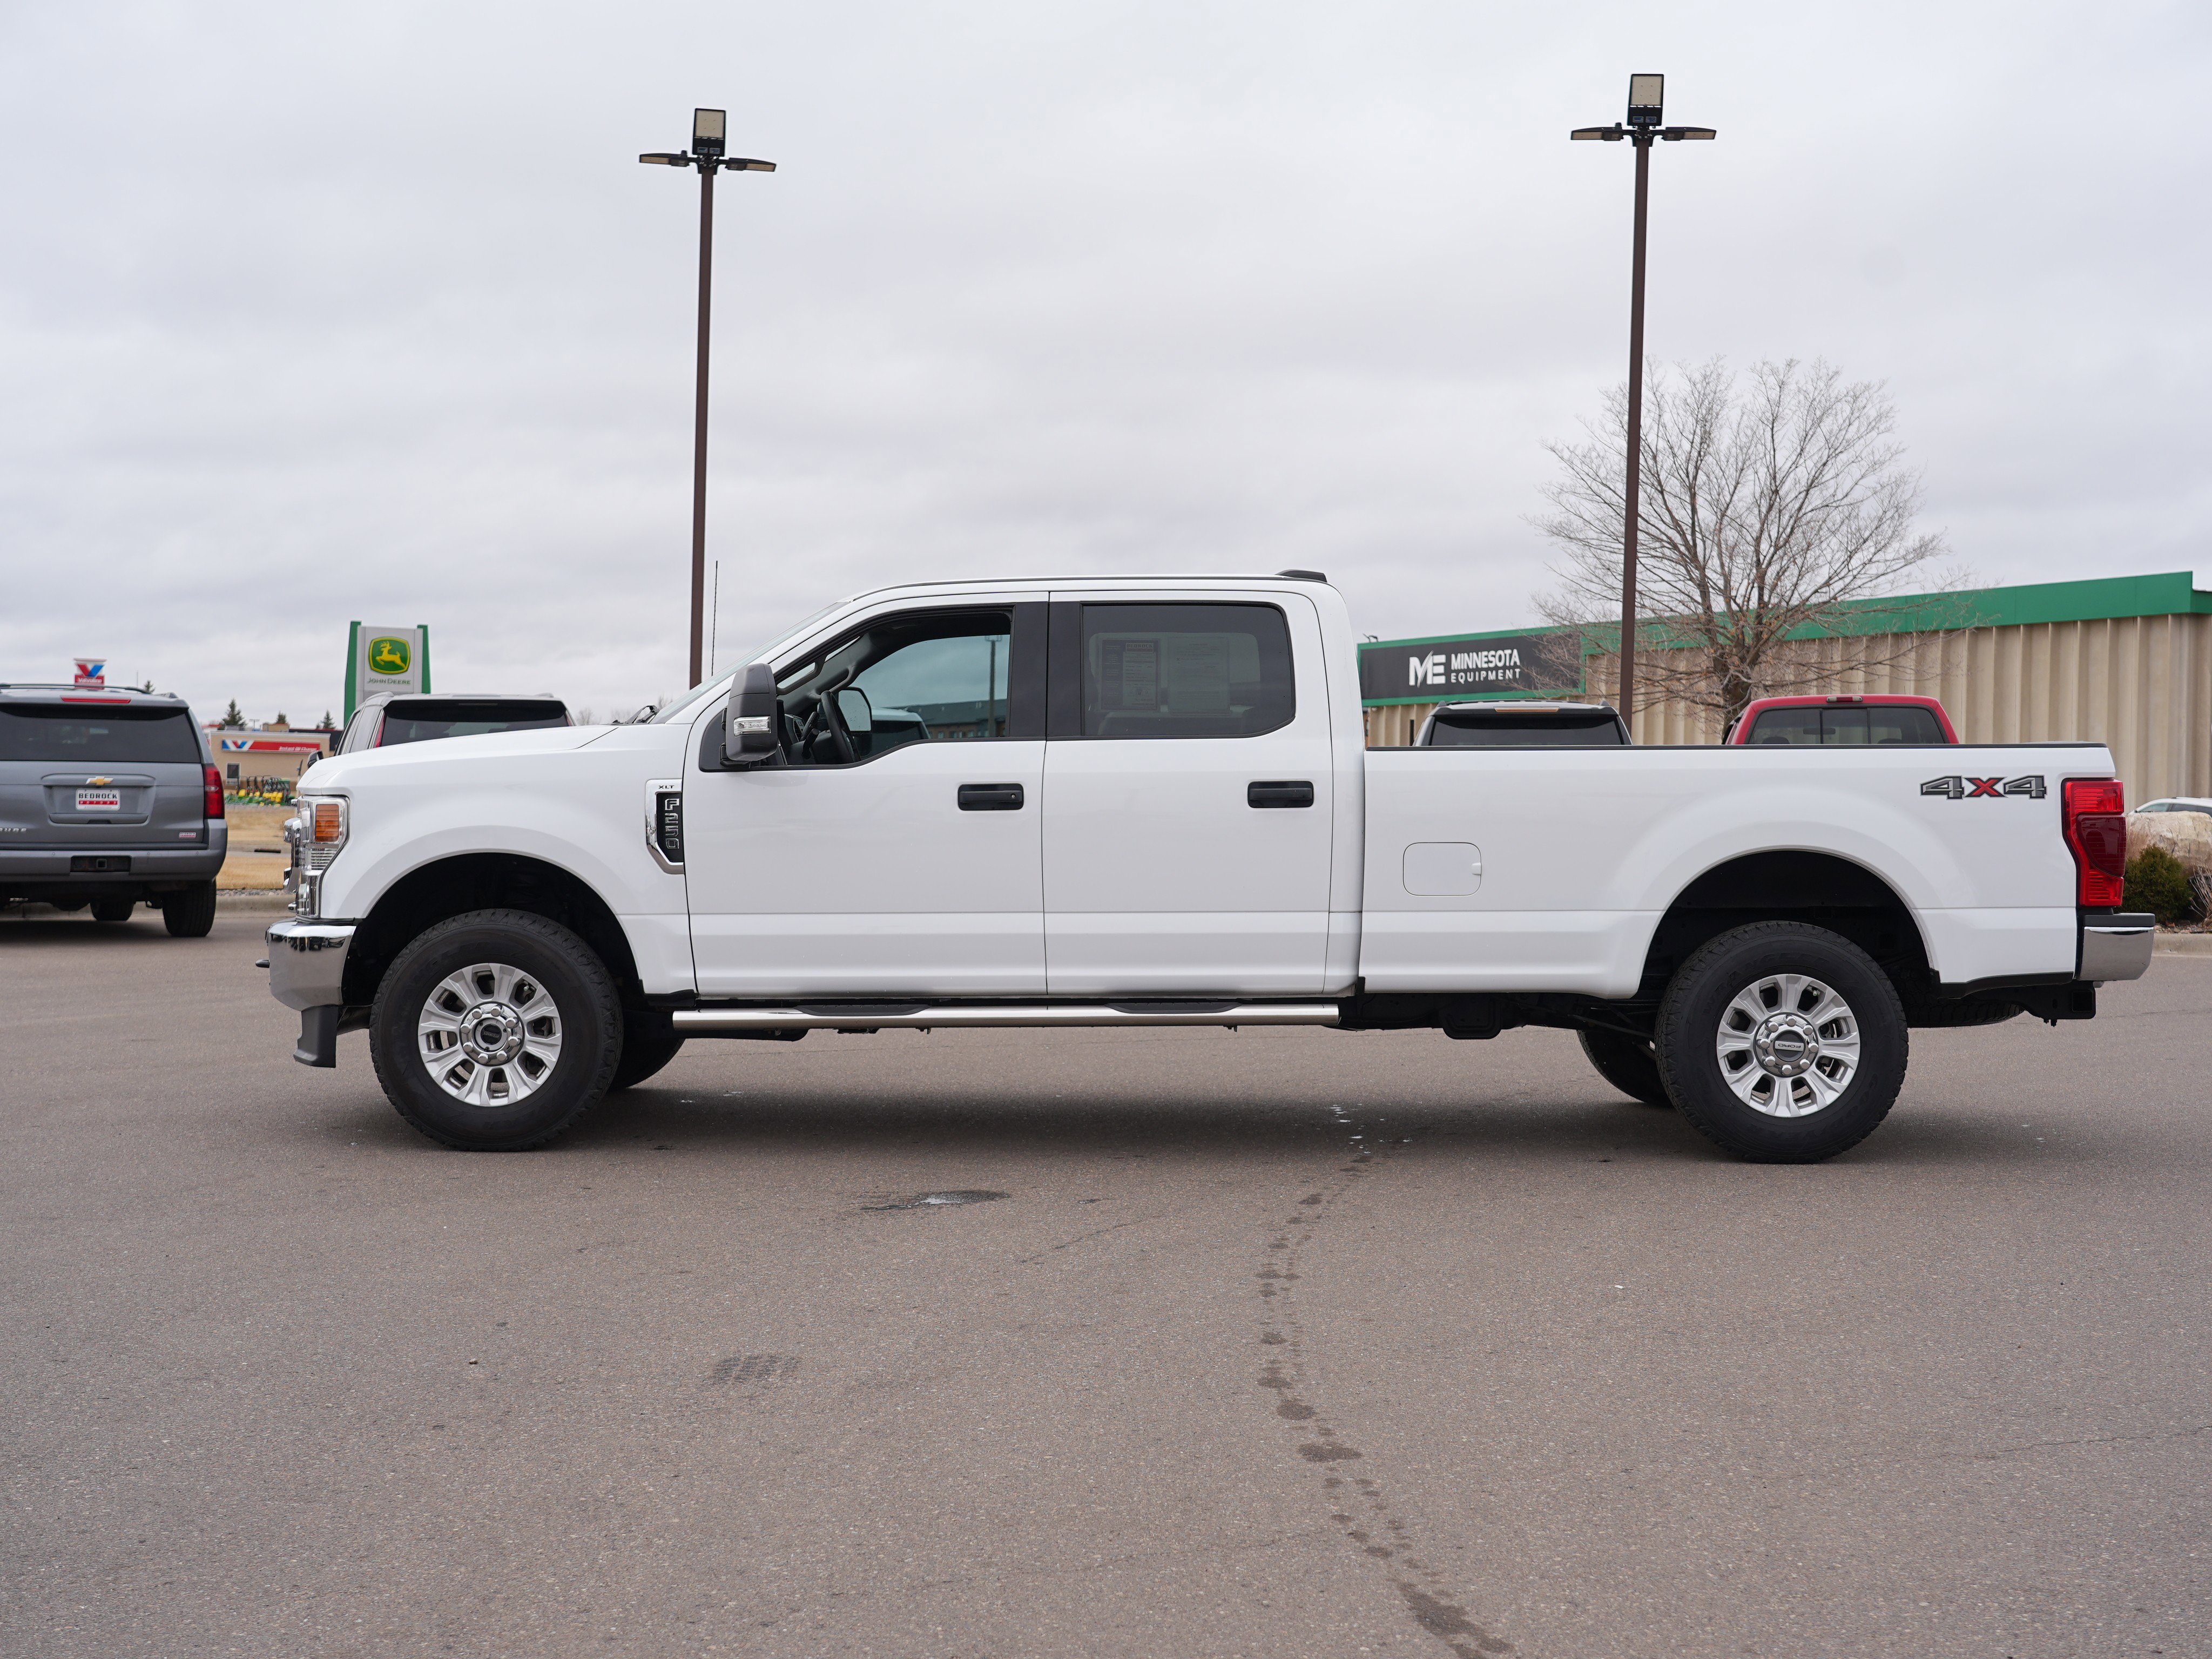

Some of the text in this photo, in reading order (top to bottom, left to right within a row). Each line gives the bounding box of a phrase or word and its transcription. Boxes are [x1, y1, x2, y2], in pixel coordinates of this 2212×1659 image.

[1409, 650, 1446, 688] ME
[1451, 649, 1521, 670] MINNESOTA
[1451, 668, 1521, 684] EQUIPMENT
[665, 798, 680, 849] F250
